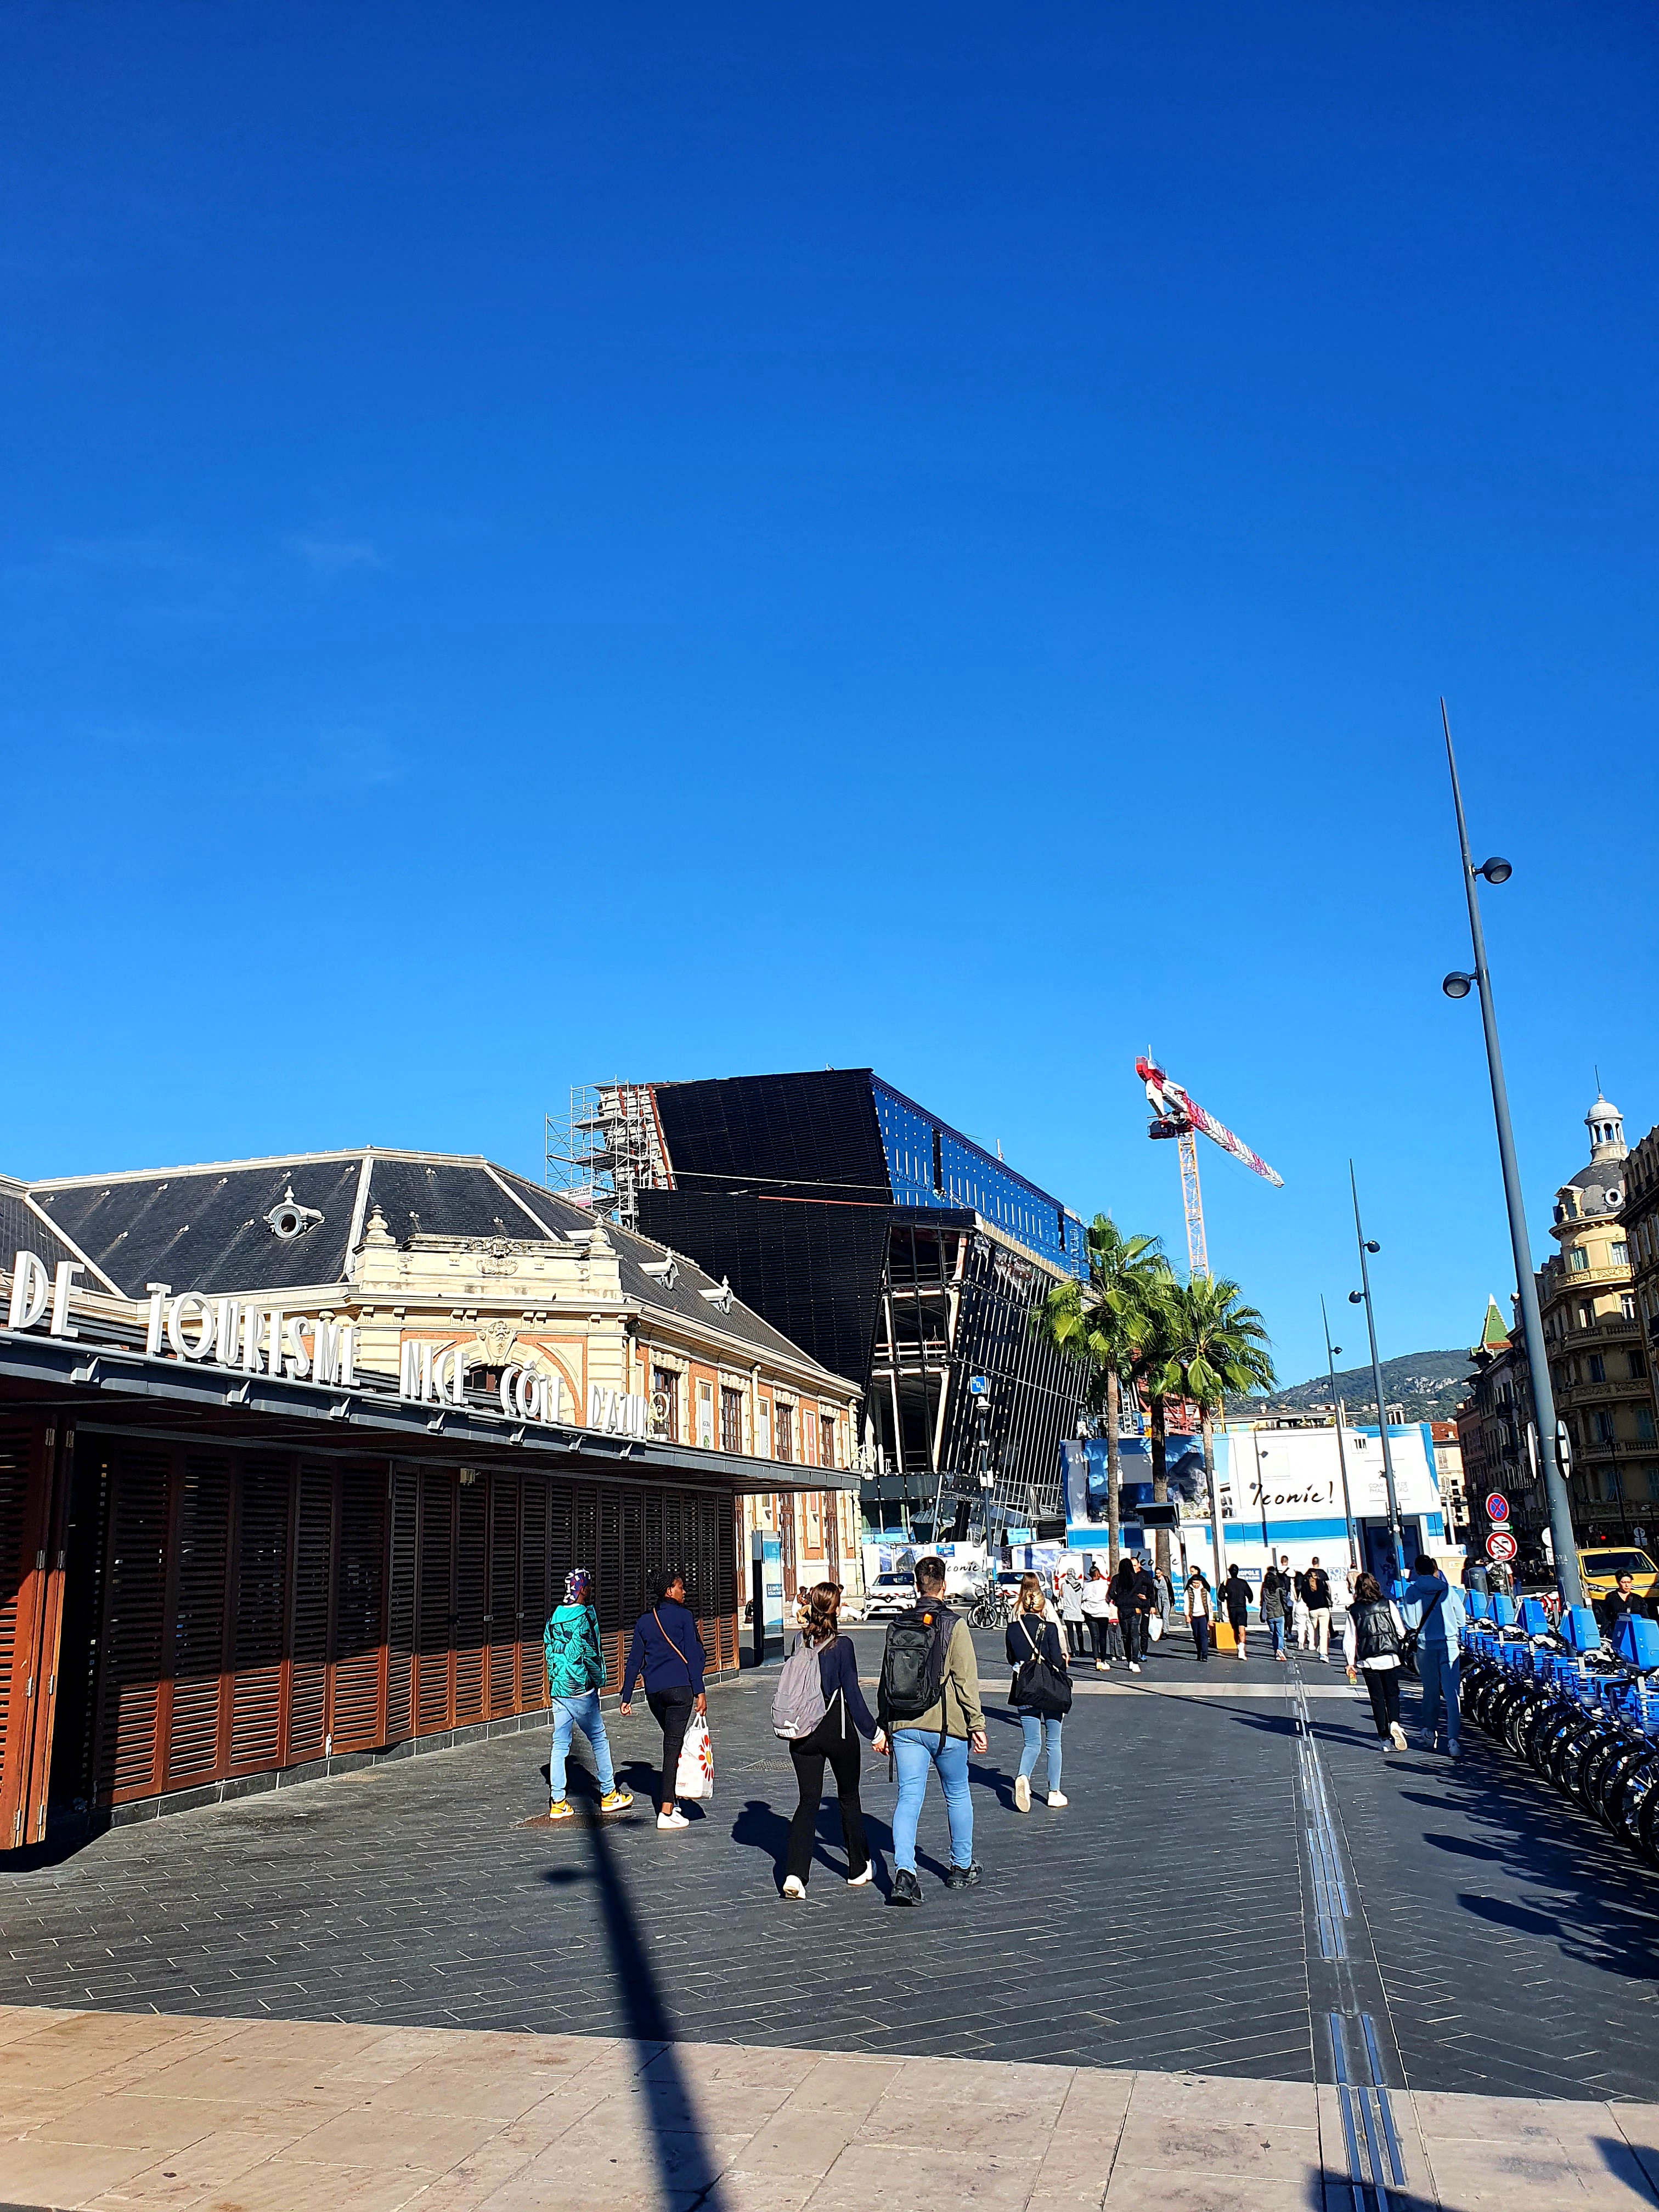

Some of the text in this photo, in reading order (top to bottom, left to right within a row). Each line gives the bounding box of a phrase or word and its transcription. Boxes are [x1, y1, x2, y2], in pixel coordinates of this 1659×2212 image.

[8, 1250, 85, 1338] DE
[146, 1282, 361, 1387] TOURISME
[399, 1341, 469, 1405] NICE
[500, 1359, 565, 1423] CÔTE
[972, 1377, 985, 1392] SOS
[1252, 1481, 1333, 1505] Iconic!
[945, 1559, 985, 1573] conic!
